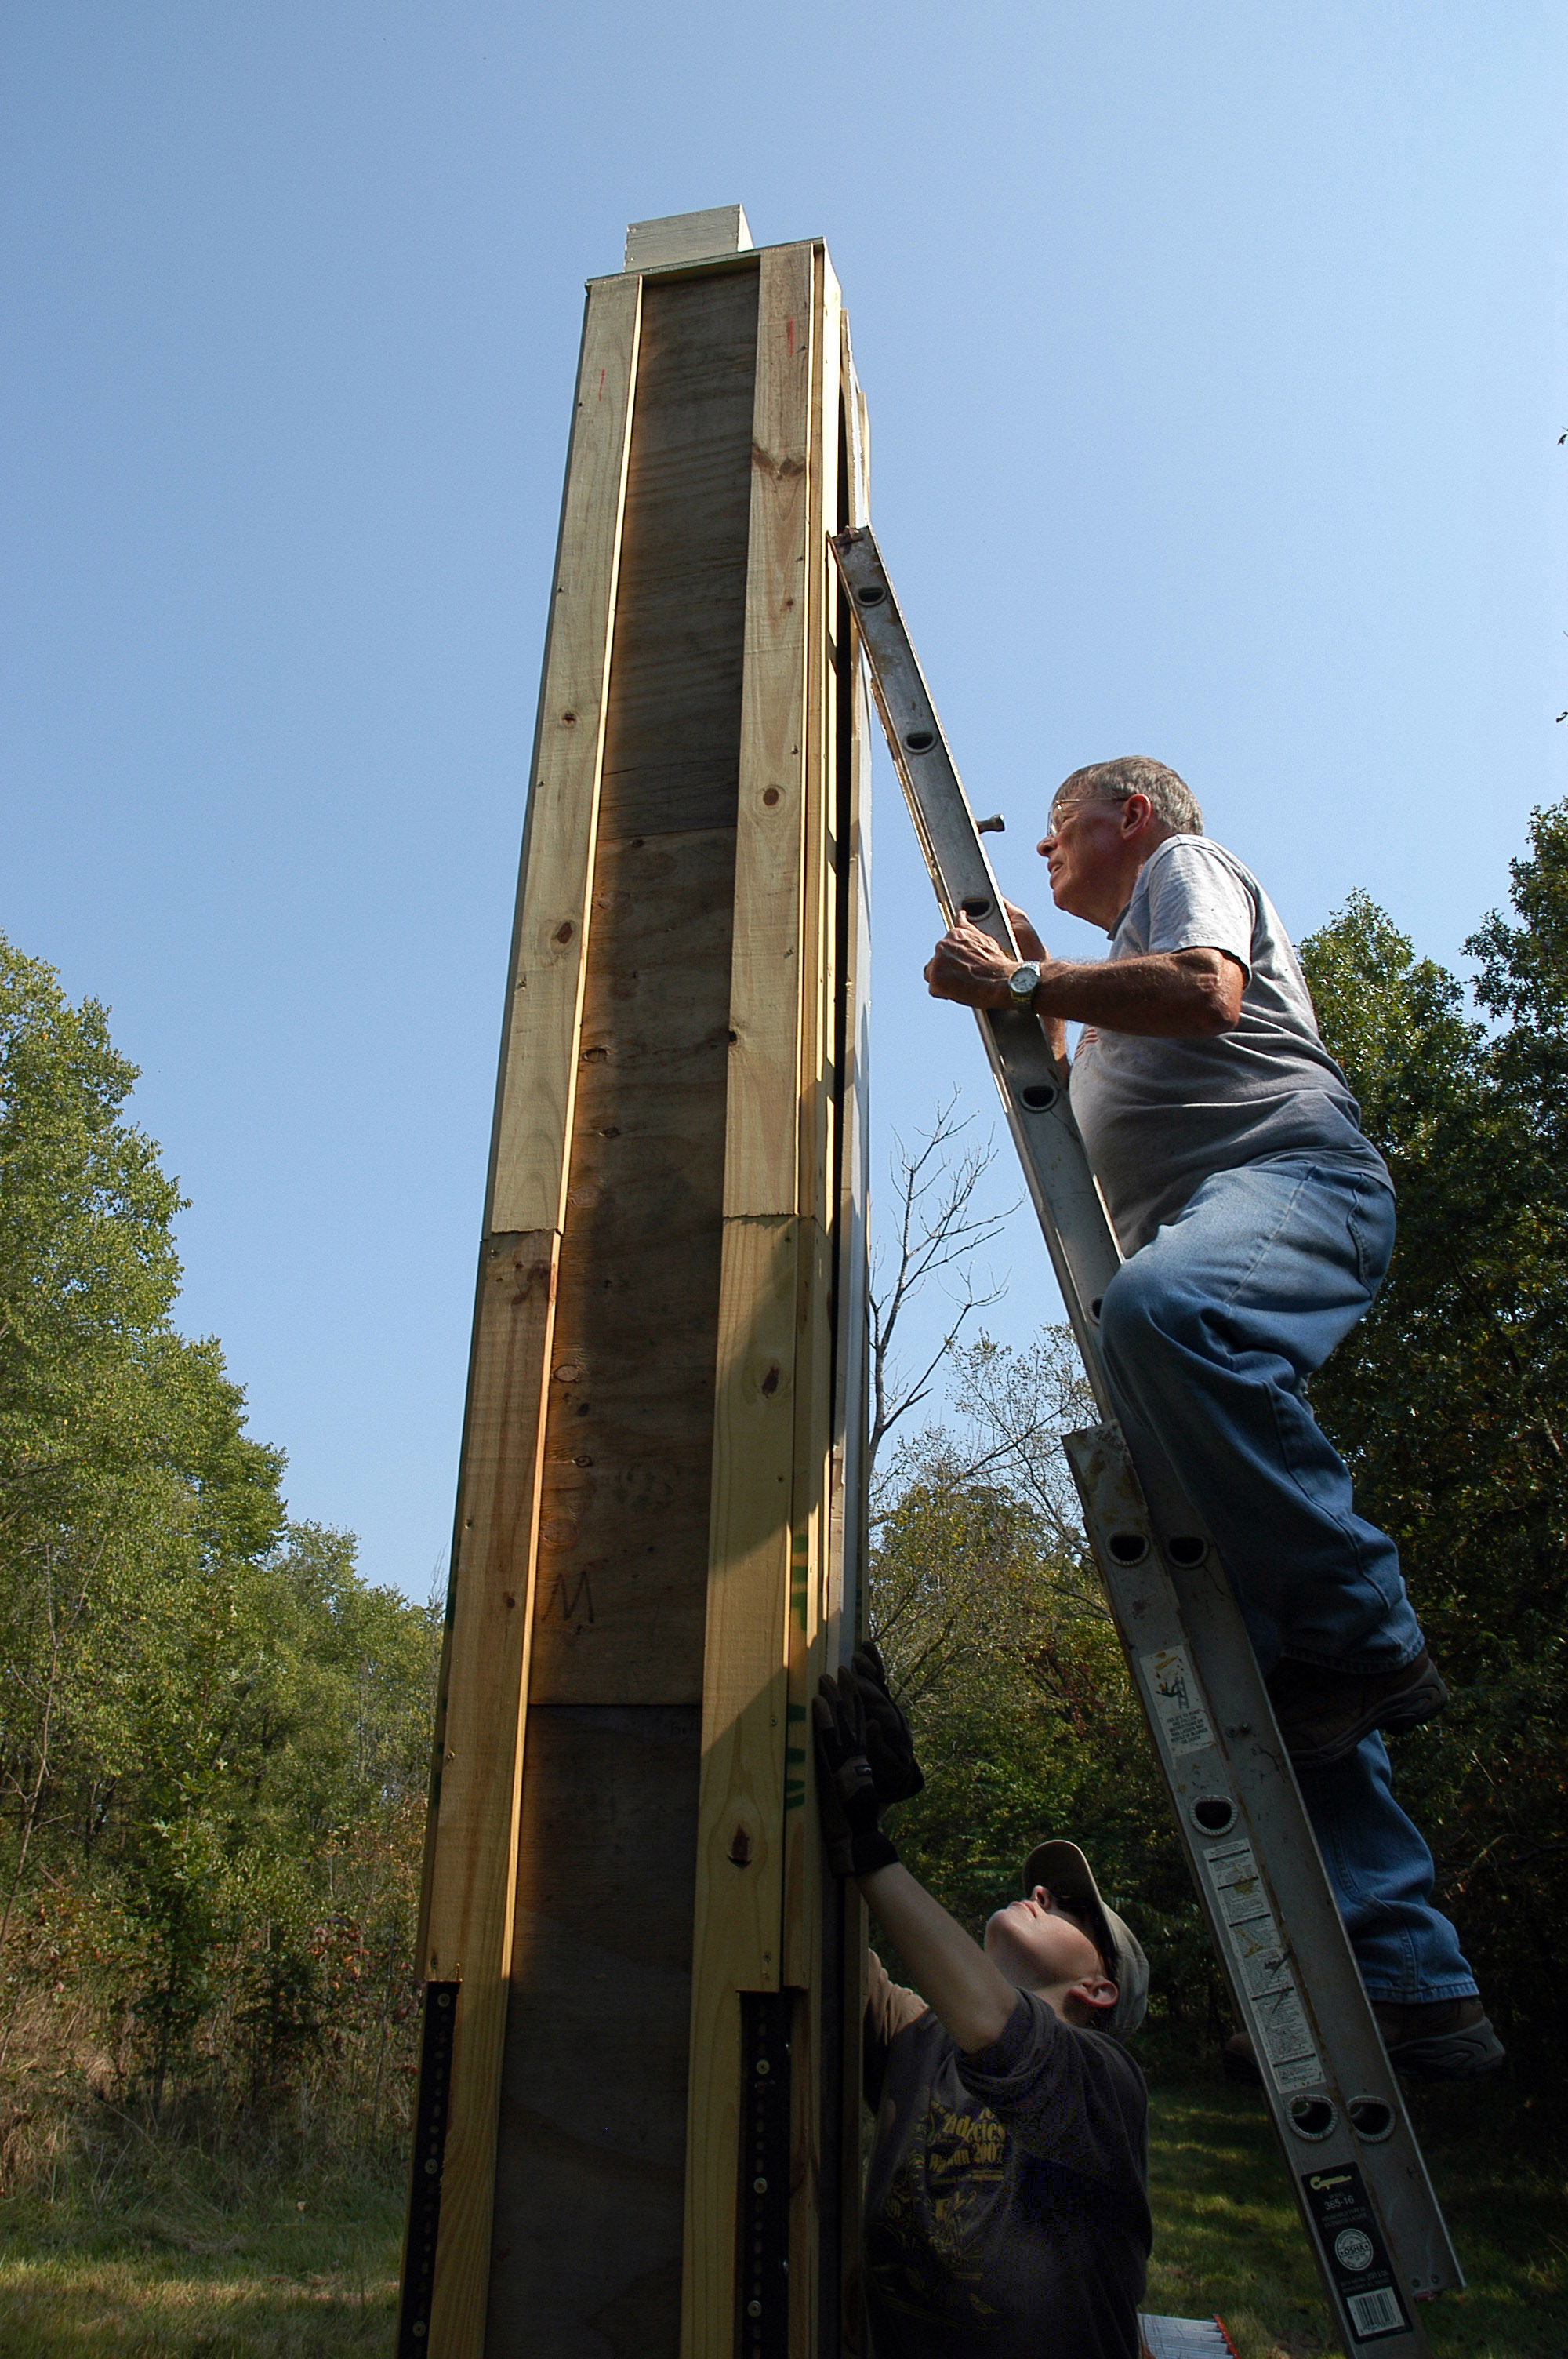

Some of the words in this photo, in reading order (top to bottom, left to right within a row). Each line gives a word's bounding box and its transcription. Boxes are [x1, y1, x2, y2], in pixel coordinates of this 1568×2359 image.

[542, 1571, 595, 1623] M
[1324, 2194, 1355, 2210] 385-16
[1344, 2244, 1364, 2255] OSHA
